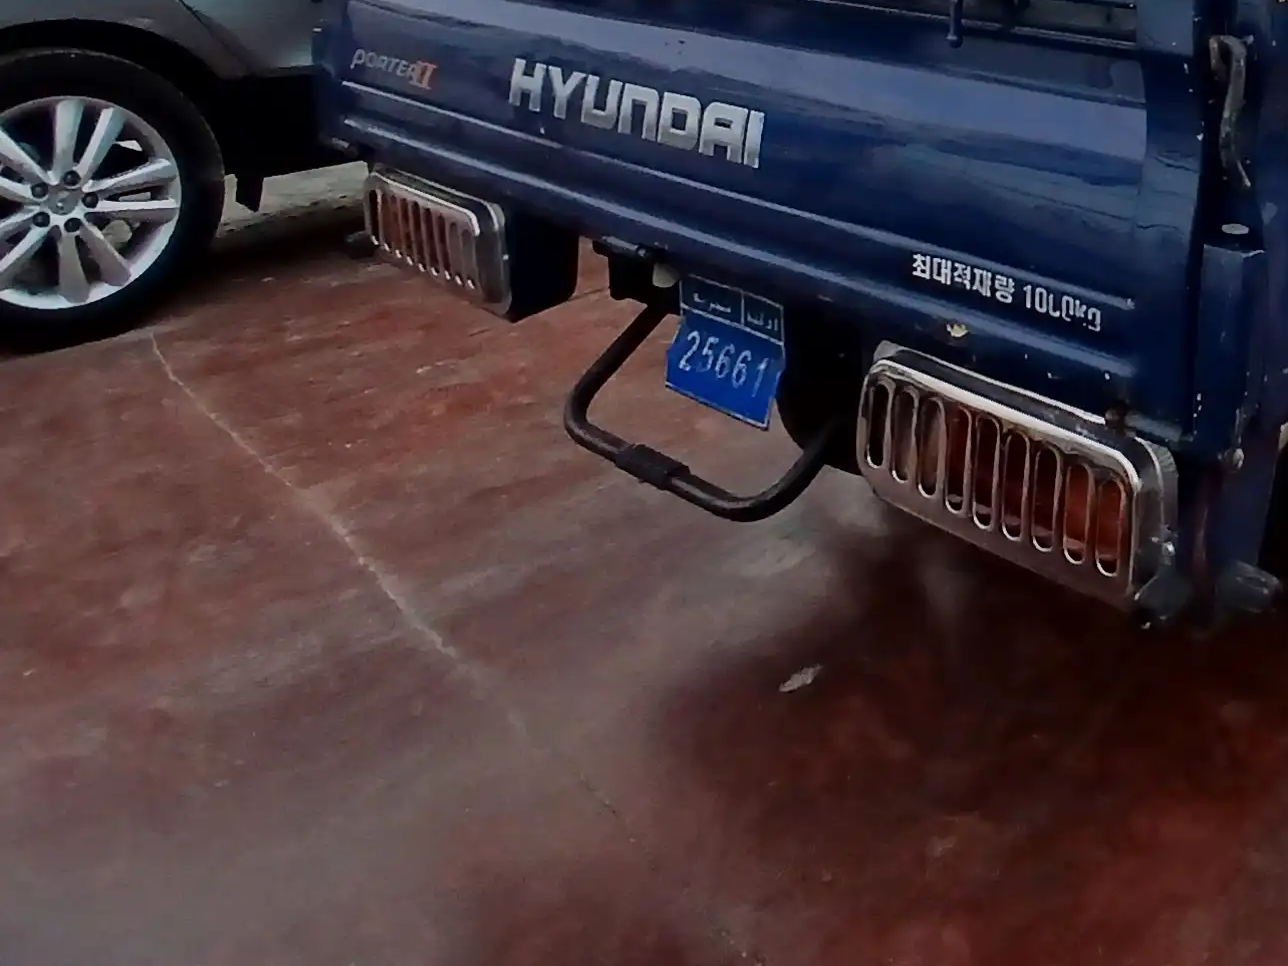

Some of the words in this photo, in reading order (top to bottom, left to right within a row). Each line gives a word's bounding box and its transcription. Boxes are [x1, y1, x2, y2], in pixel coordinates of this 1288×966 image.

[508, 57, 766, 169] HYUNDAI
[912, 253, 1015, 304] 최대적재량
[678, 330, 769, 398] 25661
